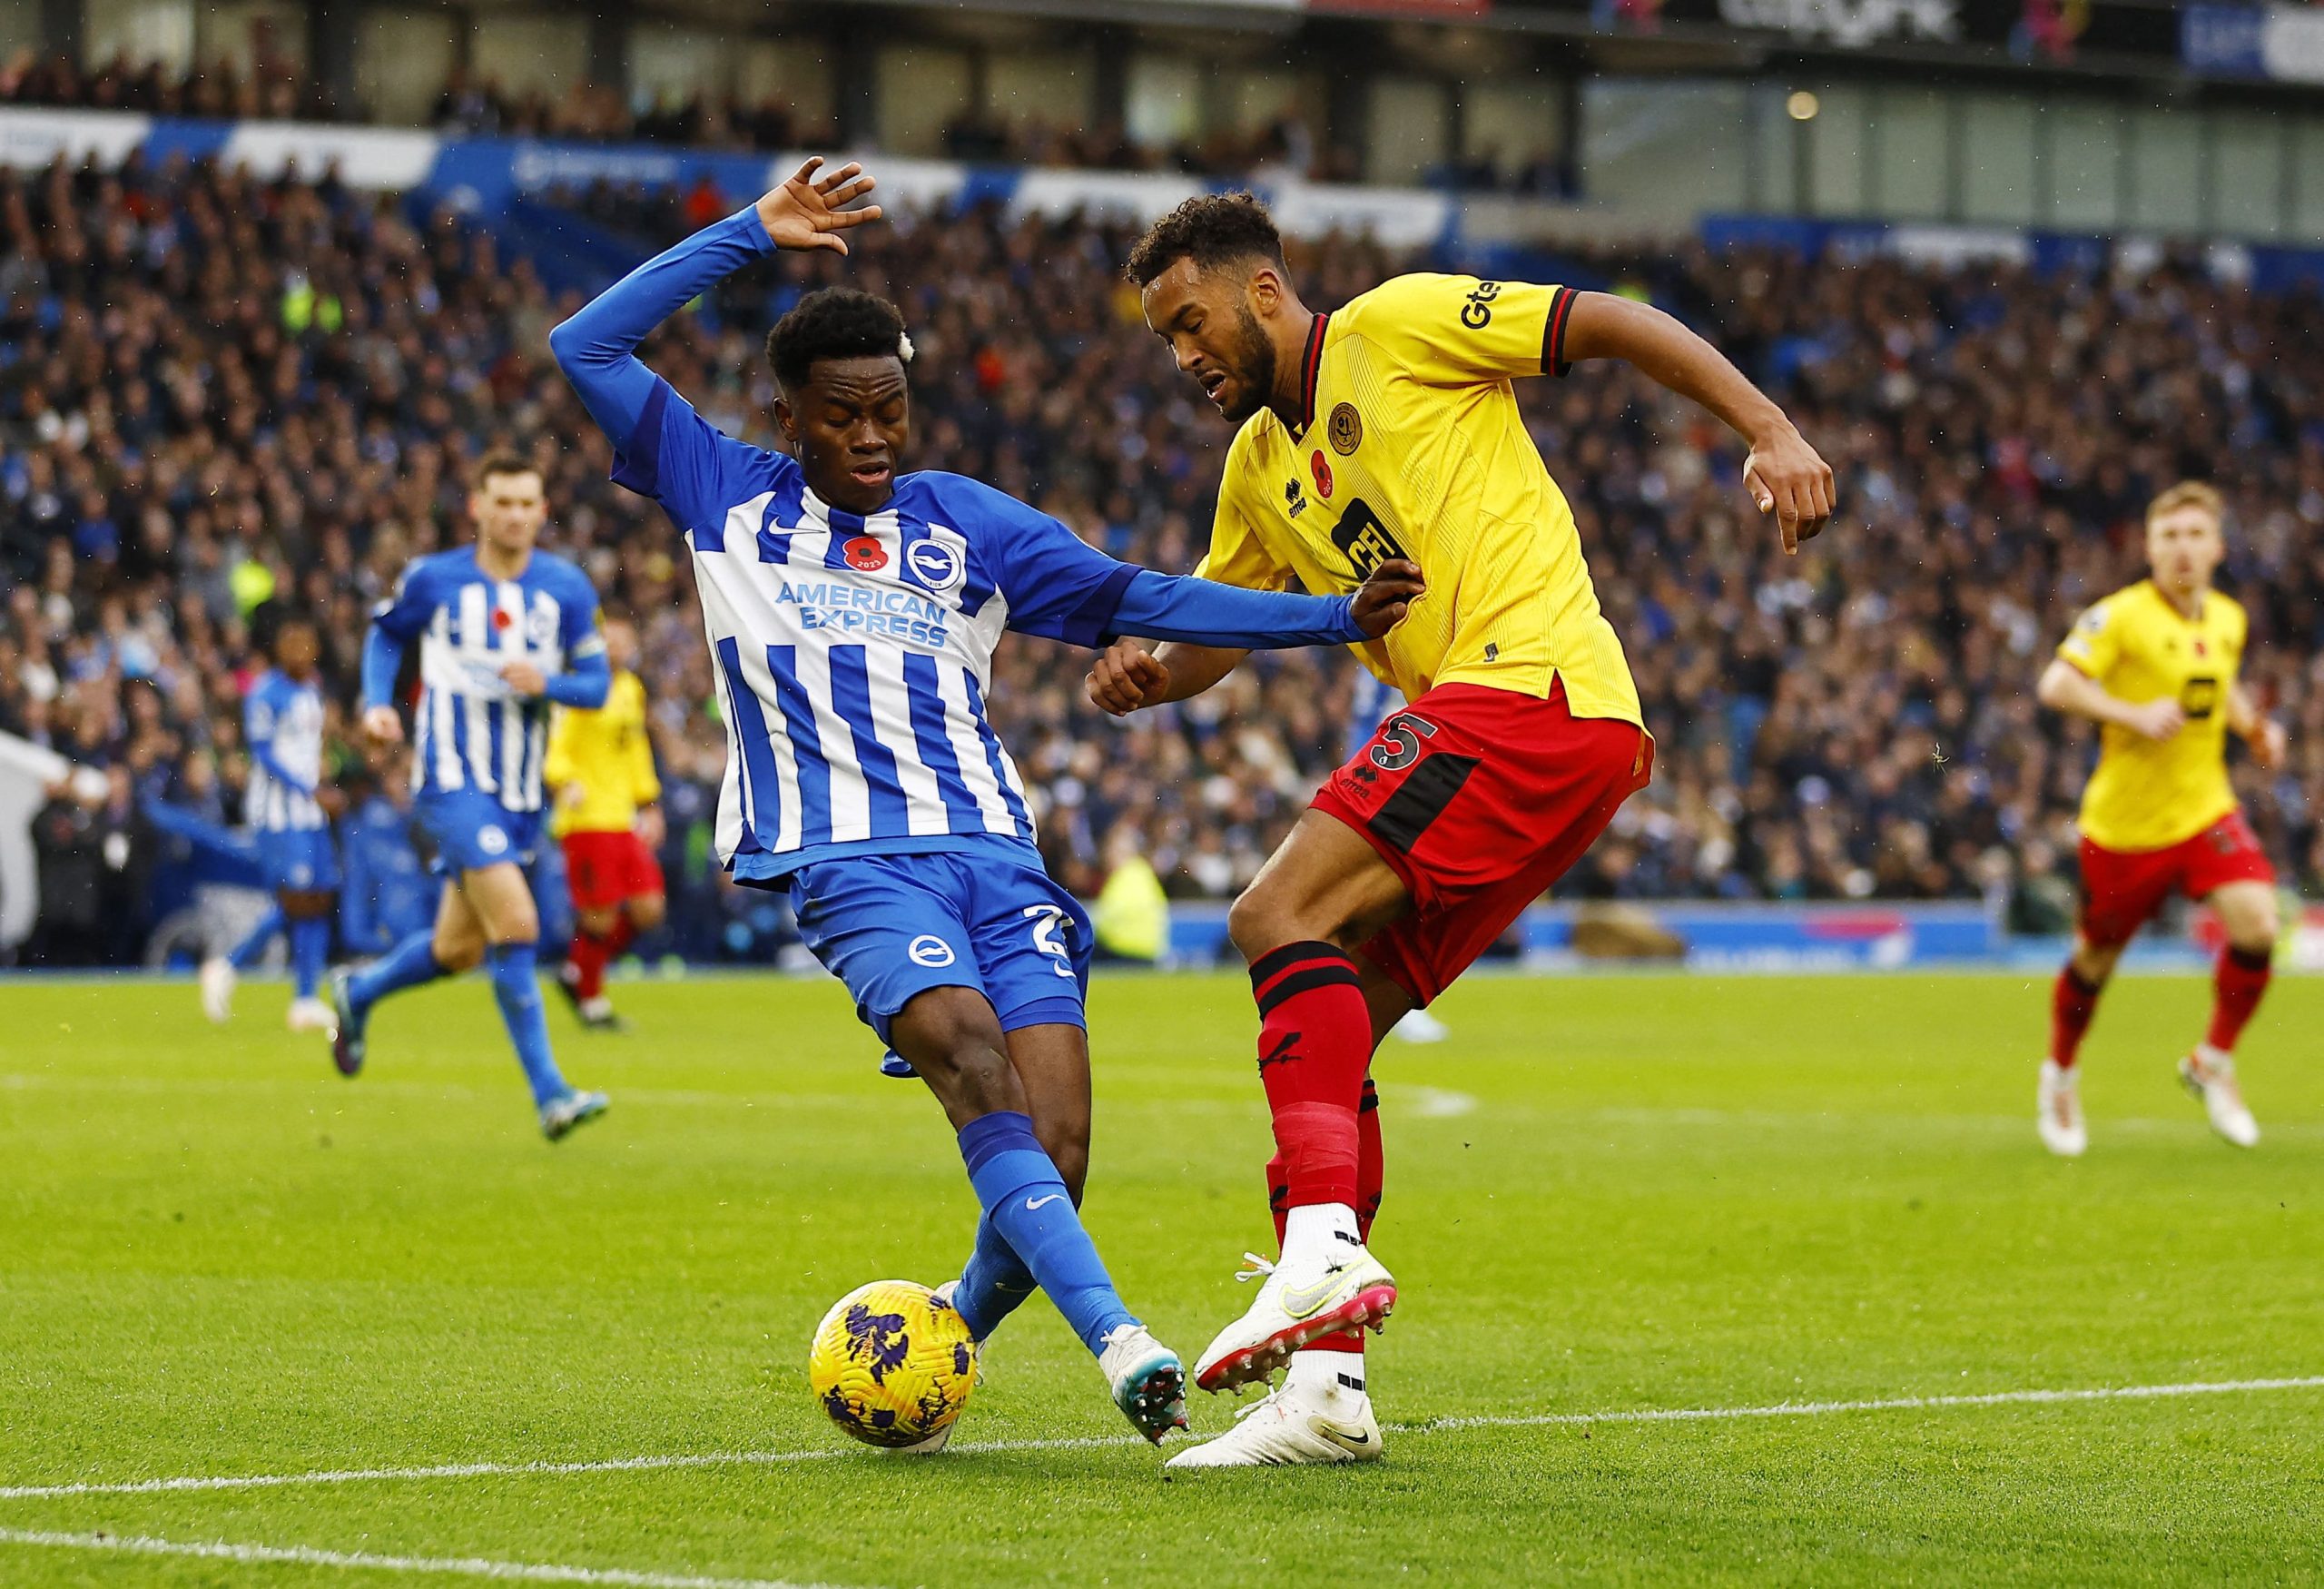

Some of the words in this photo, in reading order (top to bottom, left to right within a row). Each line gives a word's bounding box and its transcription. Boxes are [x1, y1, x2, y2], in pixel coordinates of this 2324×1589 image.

[774, 581, 947, 626] AMERICAN
[799, 606, 950, 648] EXPRESS
[1370, 712, 1439, 771] 5
